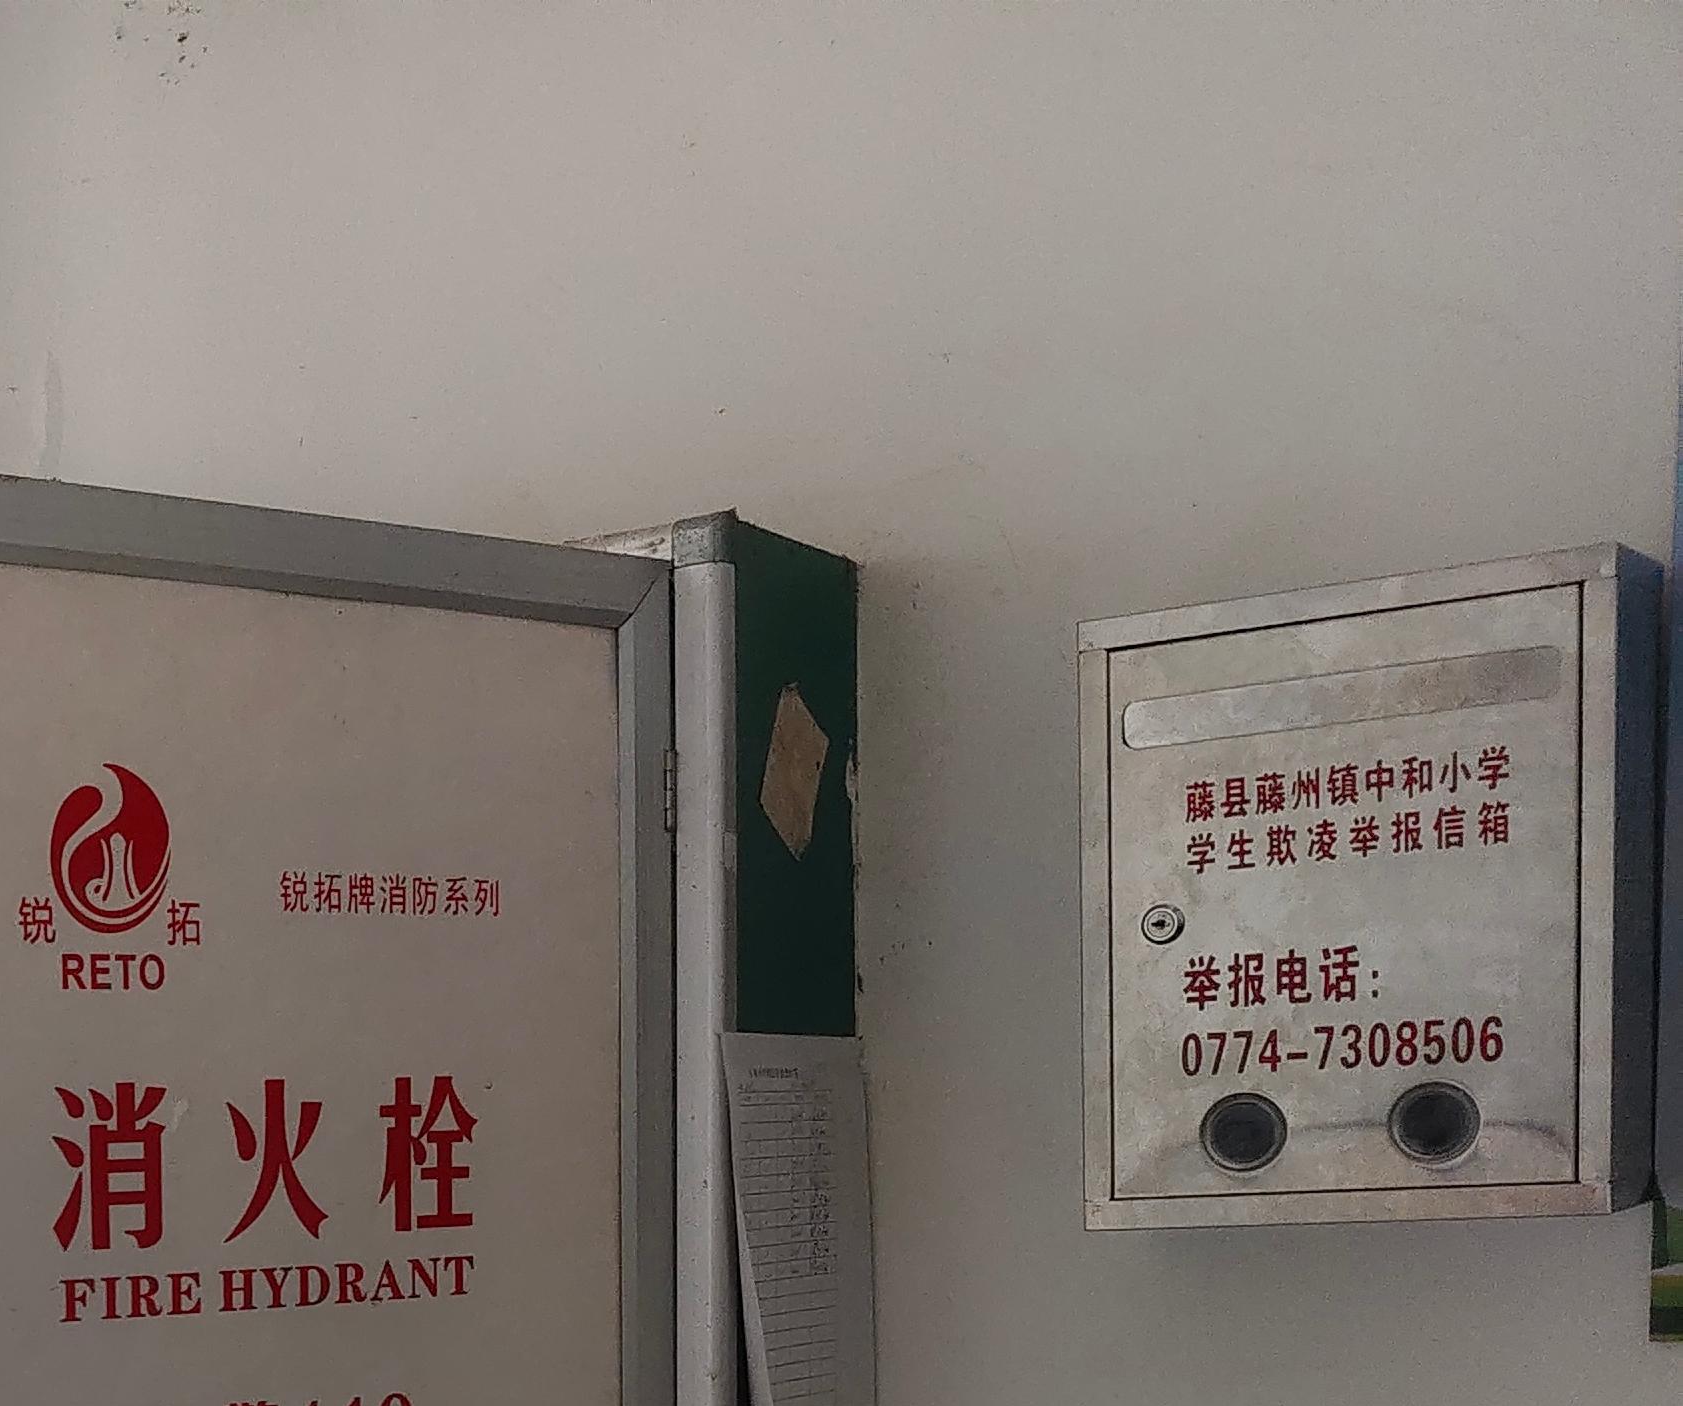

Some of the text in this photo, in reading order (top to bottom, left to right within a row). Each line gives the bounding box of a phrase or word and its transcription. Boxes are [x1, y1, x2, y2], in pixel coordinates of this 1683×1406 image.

[1184, 746, 1511, 823] 藤县藤州镇中和小学
[1184, 801, 1511, 875] 学生欺凌举报信箱
[18, 897, 202, 946] 锐 拓
[278, 870, 501, 918] 锐拓牌消防系列
[60, 952, 166, 992] RETO
[1181, 1016, 1505, 1076] 0774-7308506
[51, 1074, 479, 1252] 消火栓
[59, 1256, 474, 1324] FIRE HYDRANT
